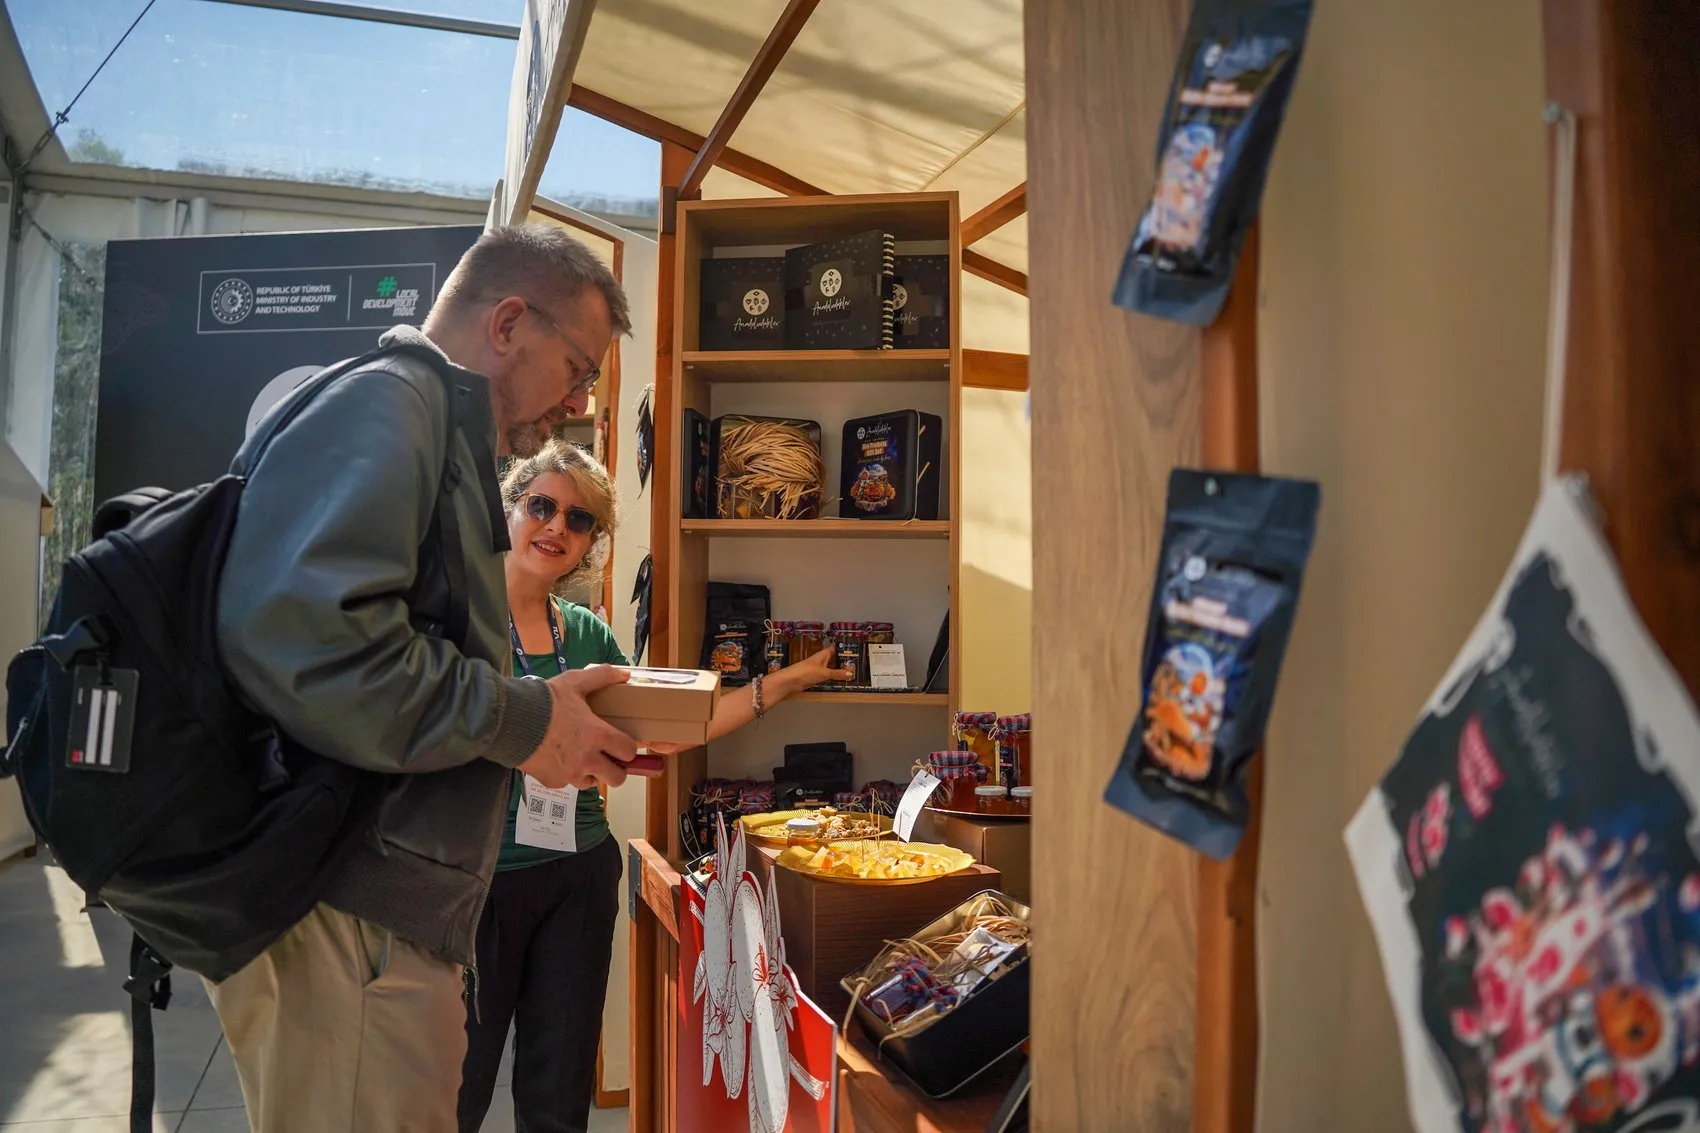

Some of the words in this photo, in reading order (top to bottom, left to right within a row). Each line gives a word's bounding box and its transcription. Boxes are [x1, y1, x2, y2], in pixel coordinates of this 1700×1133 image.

[256, 285, 291, 296] REPUBLIC
[290, 285, 301, 295] OF
[301, 283, 332, 294] TÜRKİYE
[396, 288, 420, 299] LOCAL
[255, 295, 290, 305] MINISTRY
[290, 295, 301, 304] OF
[300, 294, 338, 304] INDUSTRY
[362, 297, 418, 309] DEVELOPMENT
[254, 306, 272, 315] AND
[272, 304, 321, 314] TECHNOLOGY
